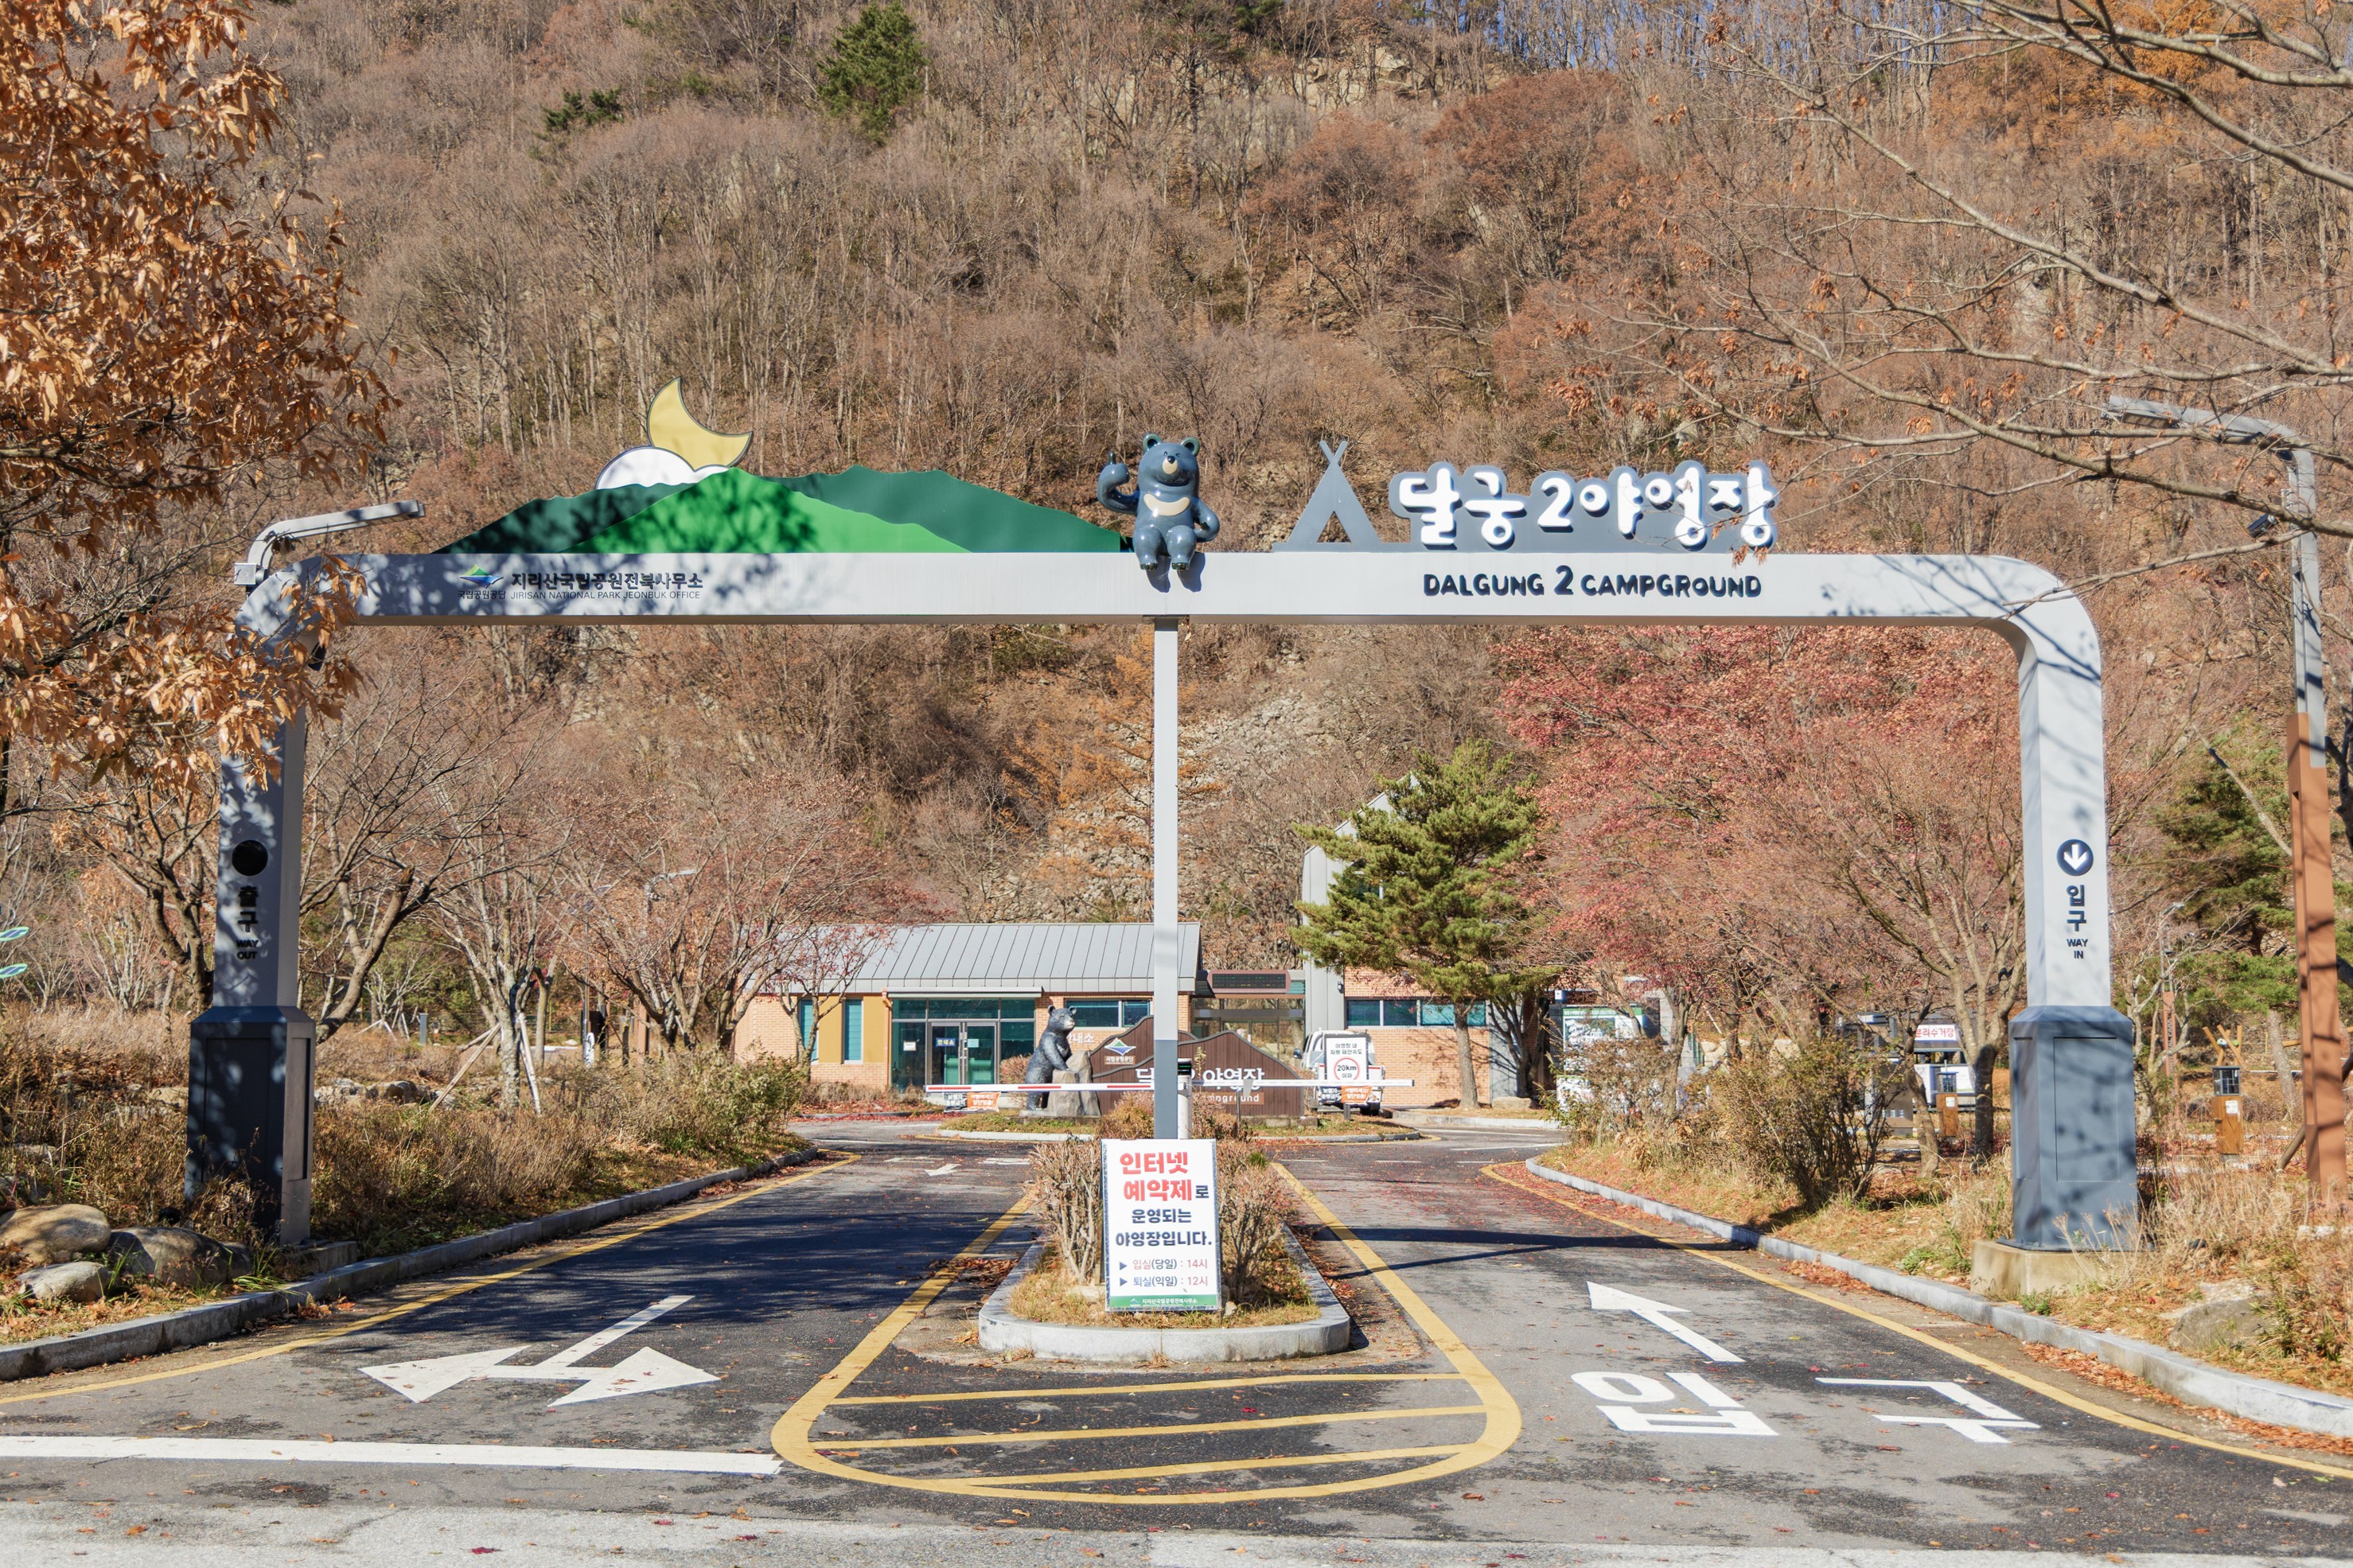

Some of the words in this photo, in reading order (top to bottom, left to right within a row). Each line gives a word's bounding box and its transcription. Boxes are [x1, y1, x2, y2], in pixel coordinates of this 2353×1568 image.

[1399, 466, 1774, 549] 달궁2야영장
[511, 572, 703, 590] 지리산국립공원전북사무소
[1423, 574, 1544, 597] DALGUNG
[1554, 565, 1573, 596] 2
[1580, 574, 1762, 597] CAMPGROUND
[458, 590, 507, 600] 국립공원공단
[510, 591, 546, 600] JIRISAN
[548, 591, 595, 600] NATIONAL
[598, 591, 621, 600] PARK
[623, 591, 667, 600] JEONBUK
[669, 591, 700, 600] OFFICE
[238, 885, 259, 933] 출구
[2066, 885, 2087, 932] 입구
[236, 940, 259, 948] WAY
[2067, 939, 2089, 947] WAY
[236, 951, 258, 960] OUT
[2073, 951, 2084, 959] IN
[1120, 1152, 1188, 1175] 인터넷
[1124, 1179, 1210, 1201] 예약제로
[1132, 1208, 1192, 1224] 운영되는
[1116, 1231, 1212, 1247] 야영장입니다.
[1132, 1259, 1178, 1270] 입실(당일)
[1186, 1259, 1208, 1270] 14시
[1133, 1275, 1178, 1287] 퇴실(익일)
[1186, 1275, 1209, 1286] 12시
